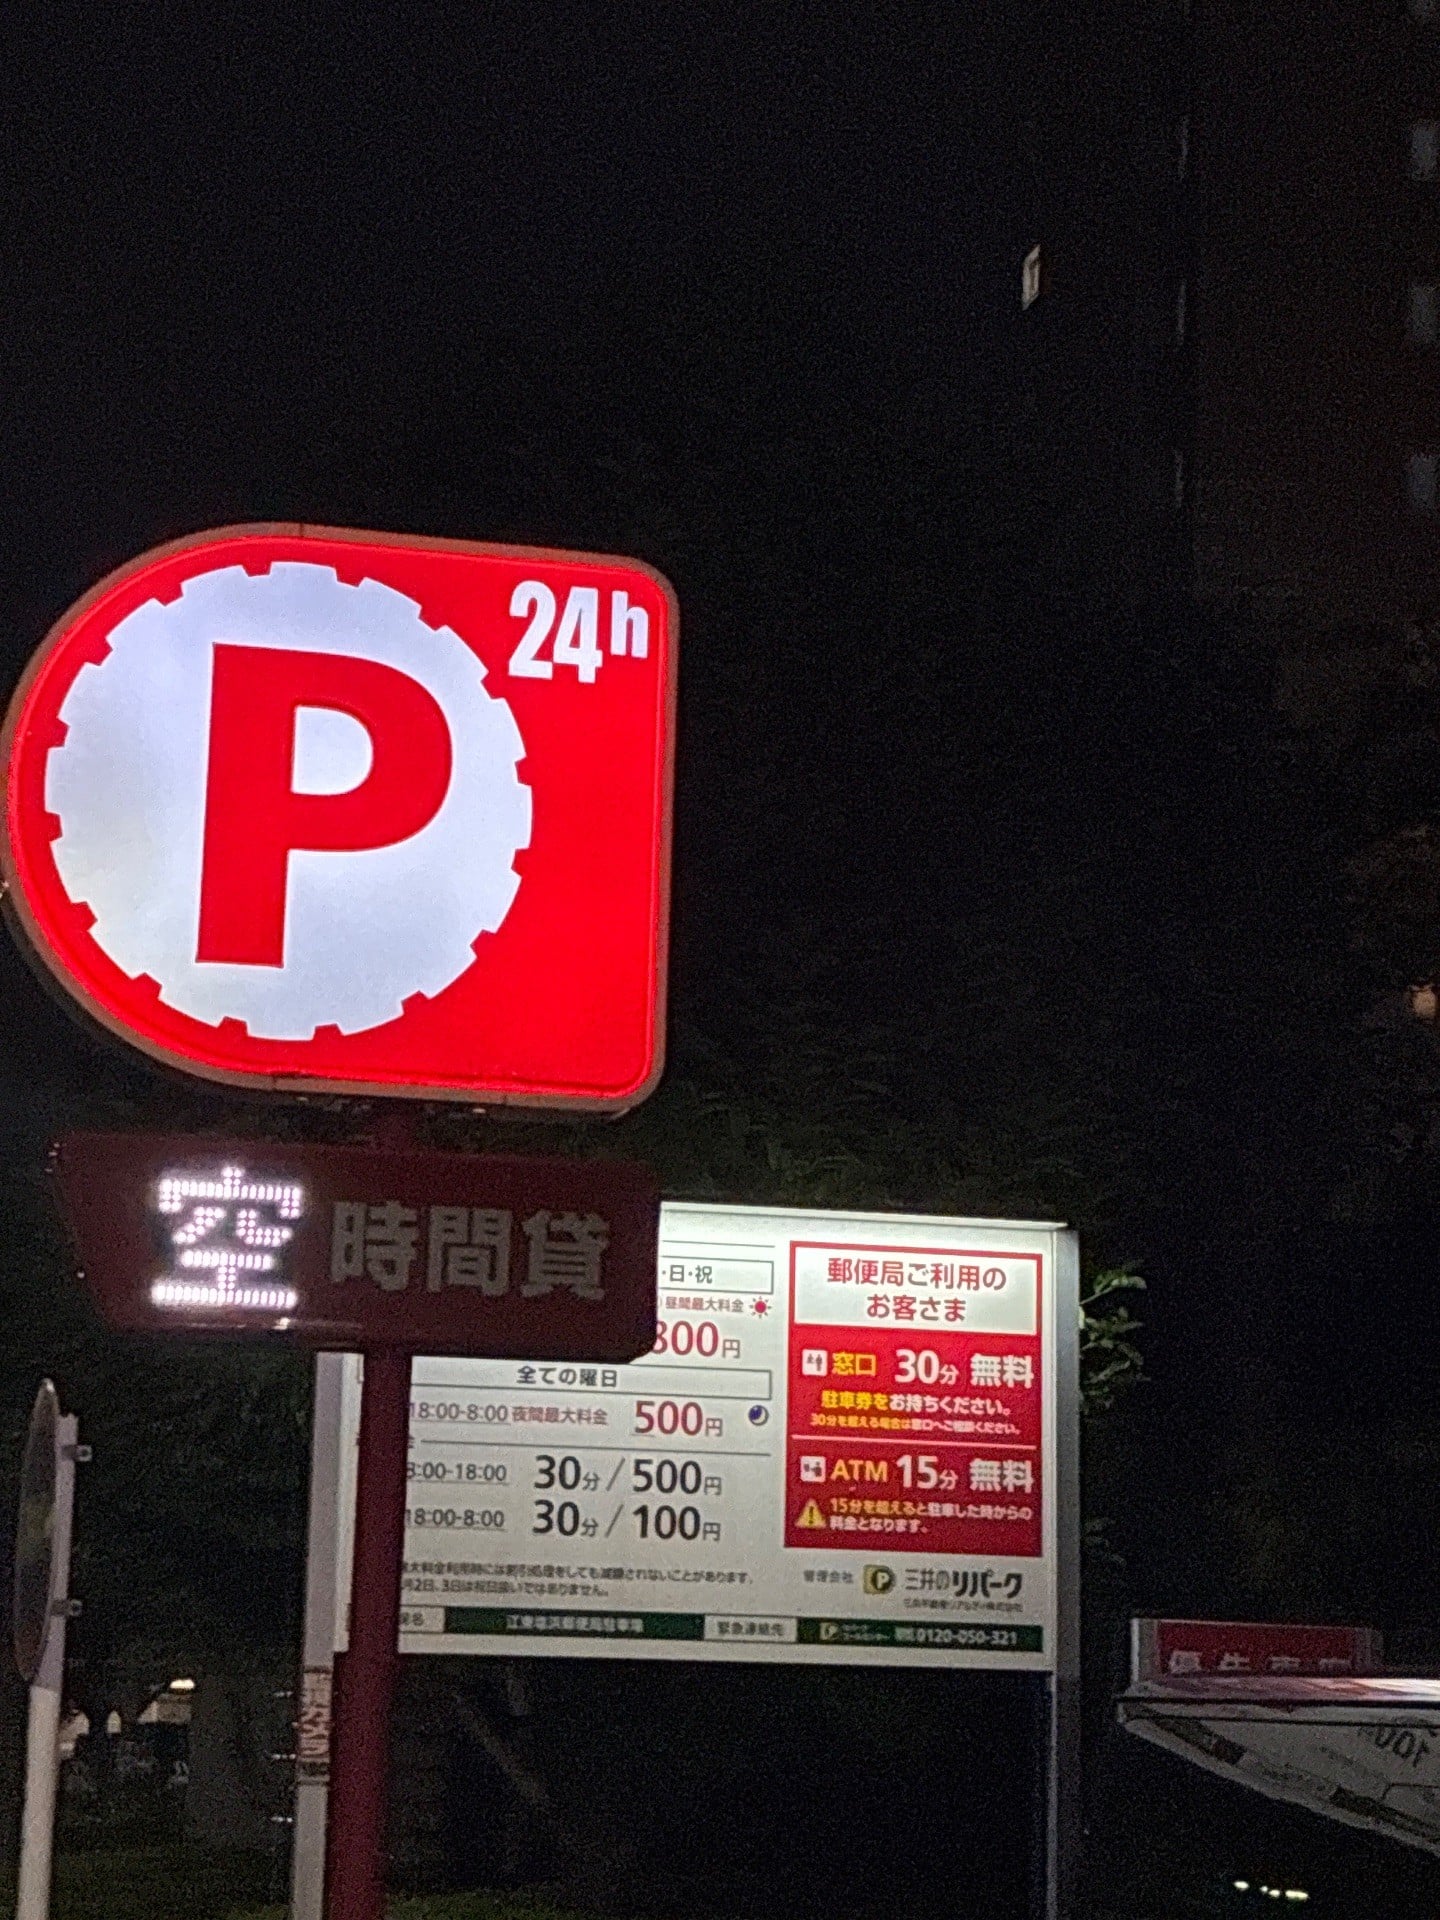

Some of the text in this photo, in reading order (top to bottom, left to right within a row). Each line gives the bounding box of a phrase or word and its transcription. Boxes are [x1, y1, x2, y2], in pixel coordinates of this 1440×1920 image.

[195, 642, 453, 967] P
[149, 1163, 304, 1310] 空
[329, 1200, 609, 1300] 時間貸
[827, 1257, 1006, 1291] 郵便局ご利用の
[866, 1294, 967, 1322] お客さま
[517, 1365, 617, 1388] 全ての曜日
[832, 1352, 877, 1377] 窓口
[970, 1353, 1035, 1389] 無料
[821, 1390, 1012, 1416] 駐車券をお持ちください。
[830, 1460, 888, 1482] ATM
[969, 1458, 1035, 1493] 無料
[904, 1567, 1023, 1598] 三井のリパーク
